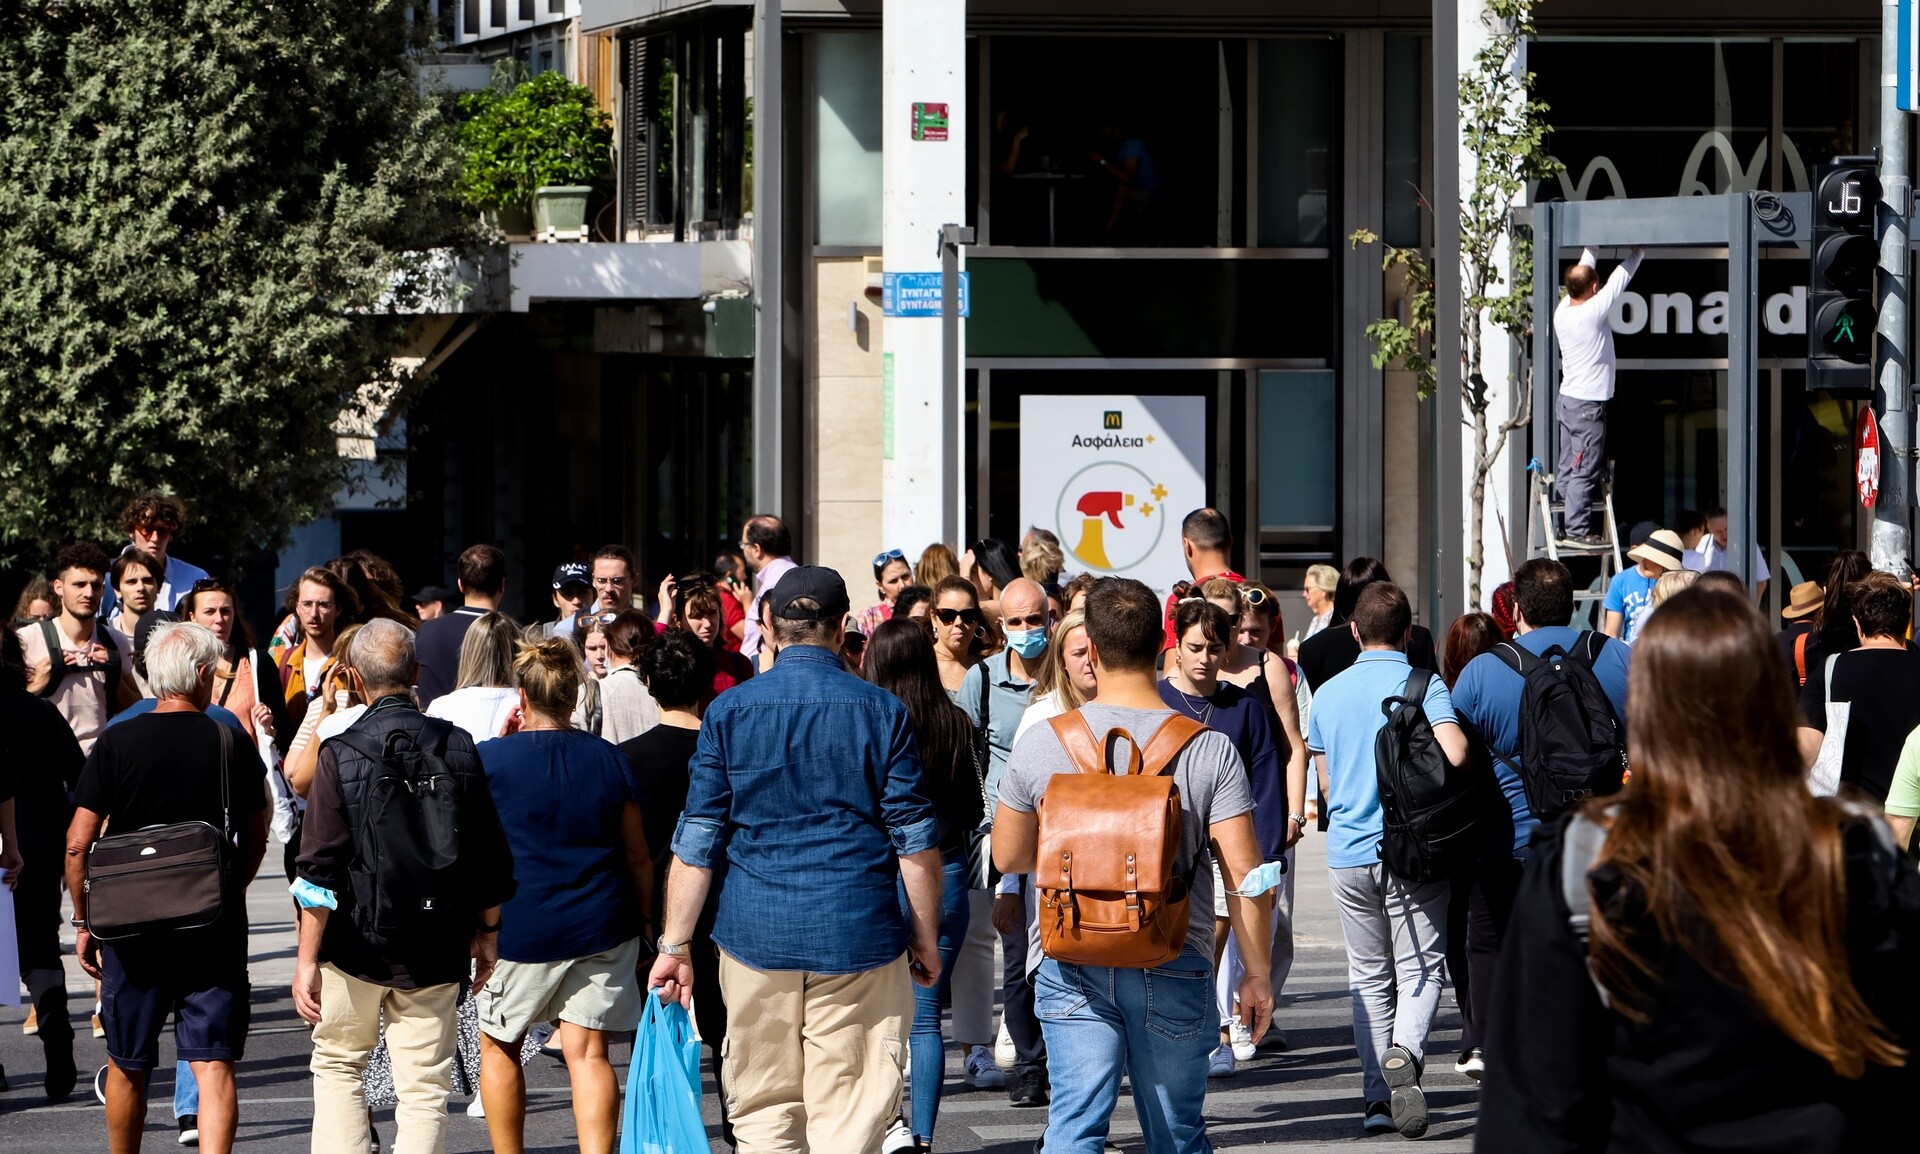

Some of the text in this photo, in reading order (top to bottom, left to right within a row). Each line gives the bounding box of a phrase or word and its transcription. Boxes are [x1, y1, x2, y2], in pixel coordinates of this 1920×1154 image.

[901, 288, 963, 298] ΣΥΝΤΑΓΜΣ
[900, 299, 963, 310] SYNTAGMS
[1608, 286, 1807, 335] onad
